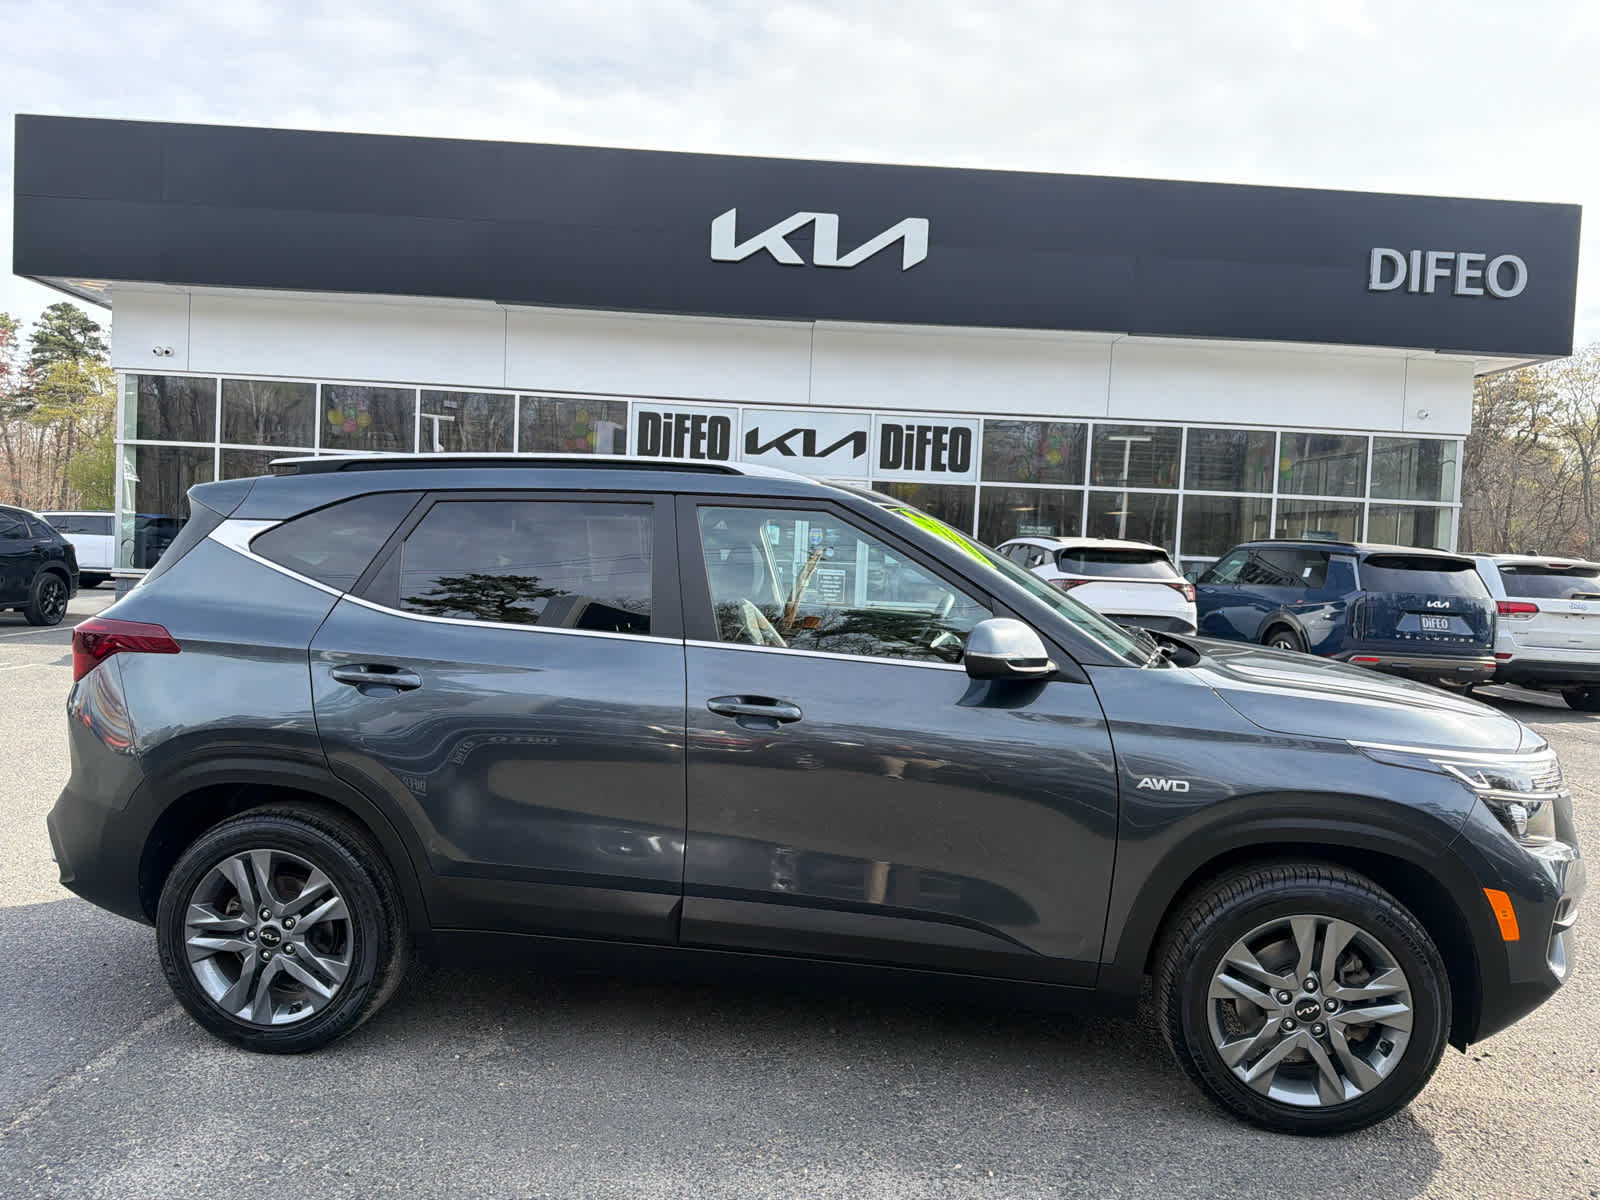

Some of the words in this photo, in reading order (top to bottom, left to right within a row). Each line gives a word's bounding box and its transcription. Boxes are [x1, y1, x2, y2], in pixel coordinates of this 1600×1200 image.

[711, 208, 929, 271] KIA
[1369, 247, 1528, 298] DIFEO
[638, 411, 731, 461] DiFEO
[745, 426, 866, 459] KIA
[879, 423, 972, 473] DiFEO
[1427, 600, 1450, 608] KIA
[1136, 777, 1190, 792] AWD
[259, 931, 281, 942] KIA
